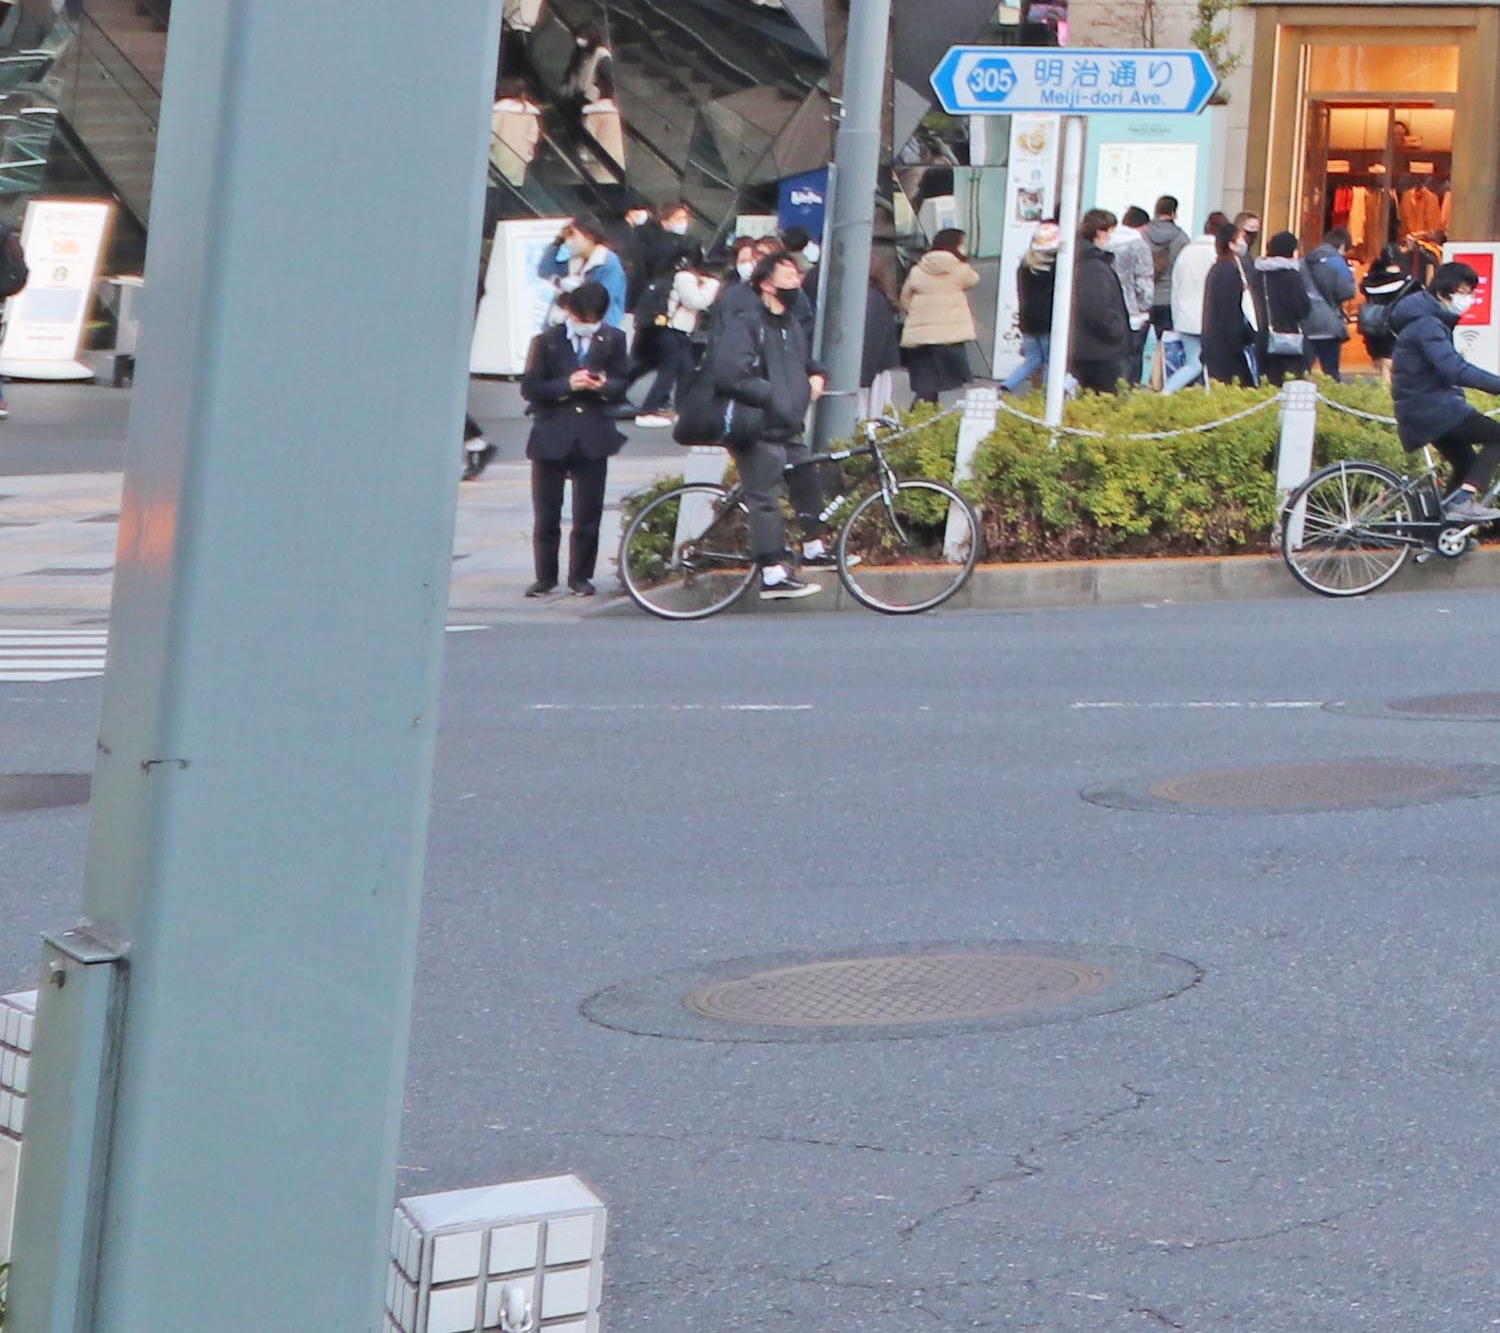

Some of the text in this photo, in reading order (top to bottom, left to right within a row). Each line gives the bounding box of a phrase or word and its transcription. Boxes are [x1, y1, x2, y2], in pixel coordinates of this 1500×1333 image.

[970, 67, 1013, 94] 305
[1033, 58, 1174, 88] 明治通り
[1039, 89, 1166, 109] Meiji-dori Ave.
